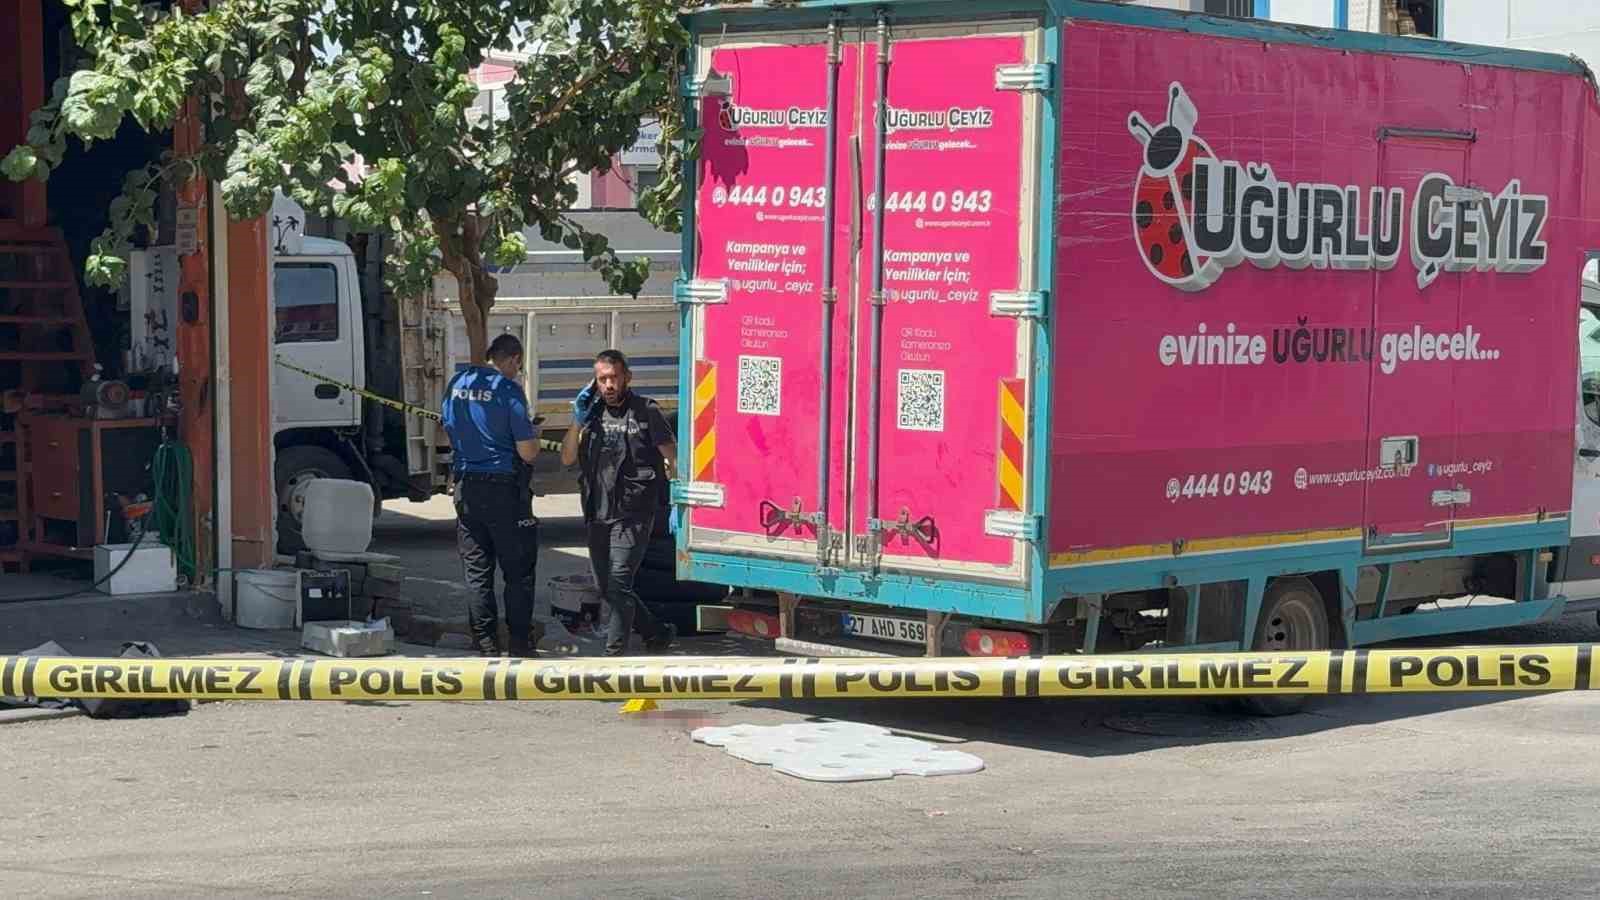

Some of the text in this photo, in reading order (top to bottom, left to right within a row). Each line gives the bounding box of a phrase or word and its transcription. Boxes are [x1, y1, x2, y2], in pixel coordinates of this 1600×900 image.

[728, 185, 827, 208] 444 0 943
[885, 190, 992, 213] 444 0 943
[1193, 158, 1549, 290] UĞURLU ÇEYİZ
[726, 241, 806, 258] Kampanya ve
[883, 249, 970, 266] Kampanya ve
[728, 258, 780, 273] Yenilikler
[885, 267, 942, 281] Yenilikler
[1159, 315, 1500, 374] evinize UĞURLU gelecek...
[1182, 470, 1273, 499] 444 0 943
[850, 616, 924, 641] 27 AHD 569
[329, 667, 463, 695] POLİS
[1389, 654, 1551, 687] POLİS
